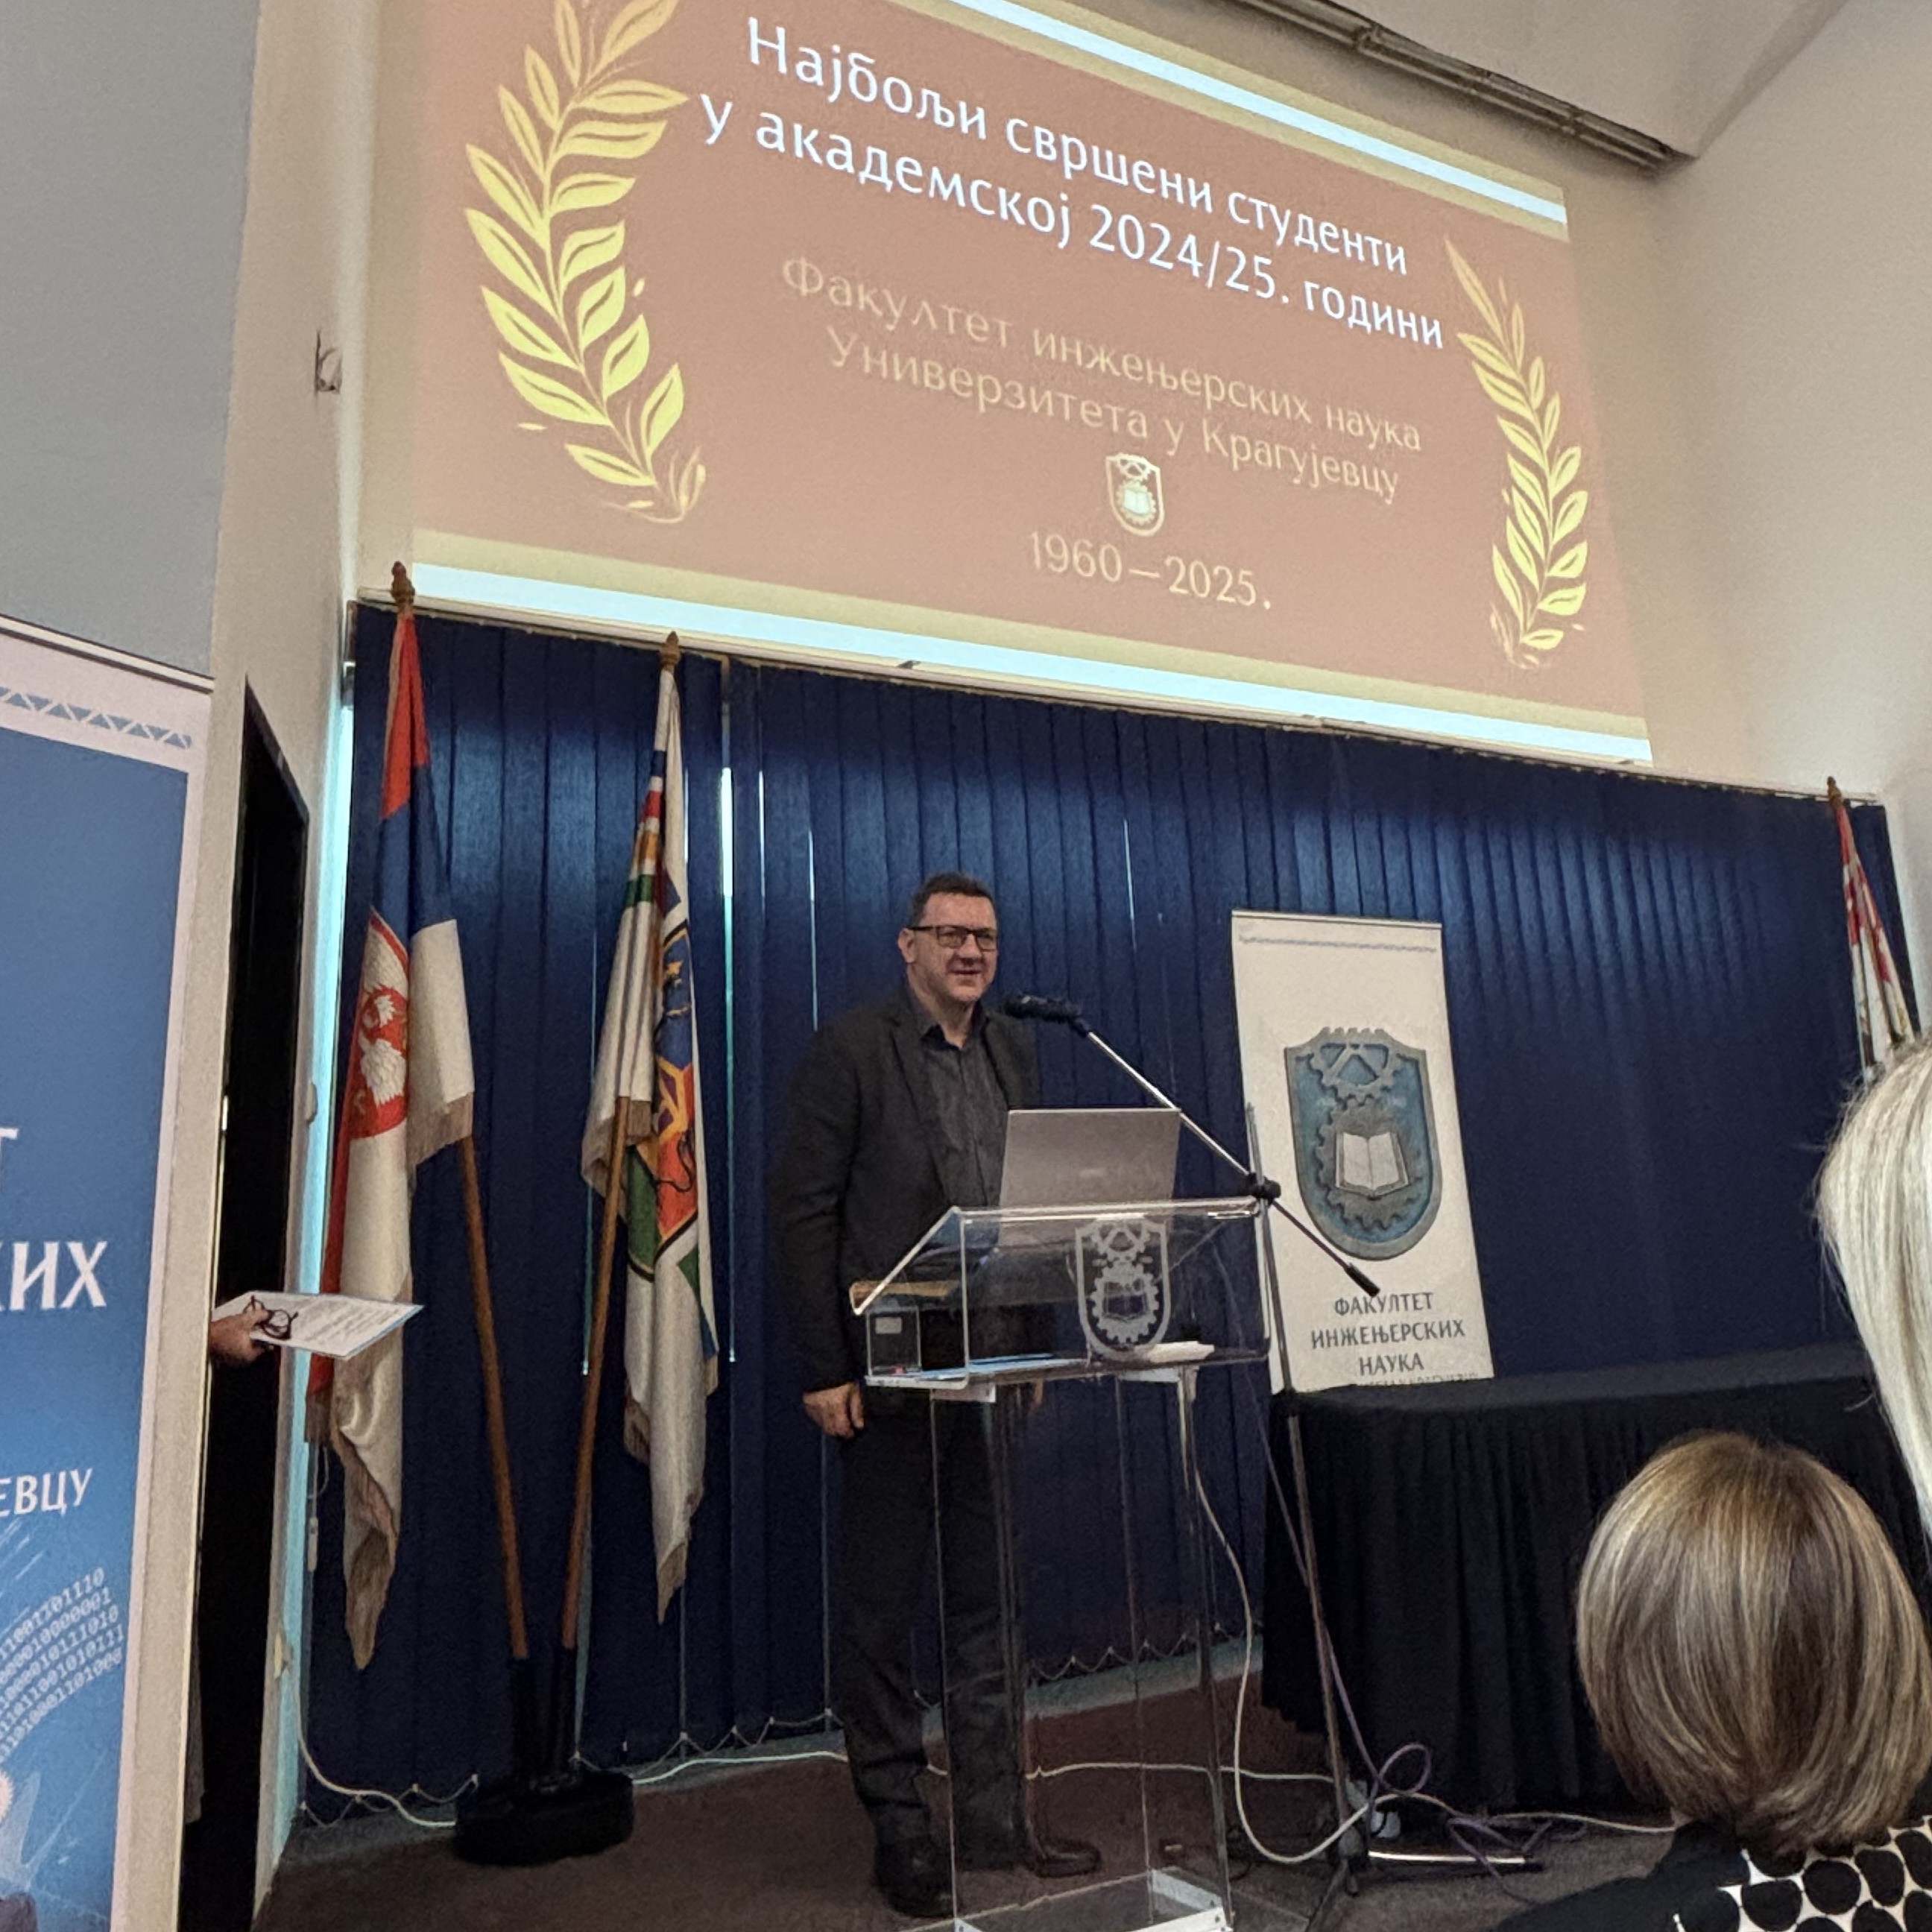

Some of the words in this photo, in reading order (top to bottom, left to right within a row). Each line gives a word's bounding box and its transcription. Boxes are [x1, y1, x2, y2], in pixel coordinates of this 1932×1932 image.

[748, 16, 986, 140] Најбољи
[1006, 119, 1213, 214] свршени
[1228, 192, 1407, 275] студенти
[700, 93, 733, 145] у
[756, 112, 1070, 249] академској
[1089, 204, 1289, 303] 2024/25.
[1304, 281, 1443, 349] години
[782, 256, 1013, 348] Факултет
[1033, 328, 1312, 423] инжењерских
[1326, 404, 1422, 451] наука
[827, 325, 1149, 438] Универзитета
[1164, 419, 1184, 455] у
[1202, 418, 1399, 505] Крагујевцу
[0, 1240, 107, 1310] ИХ
[1311, 1319, 1465, 1349] ИНЖЕЊЕРСКИХ
[1334, 1292, 1433, 1316] ФАКУЛТЕТ
[1359, 1352, 1424, 1376] НАУКА
